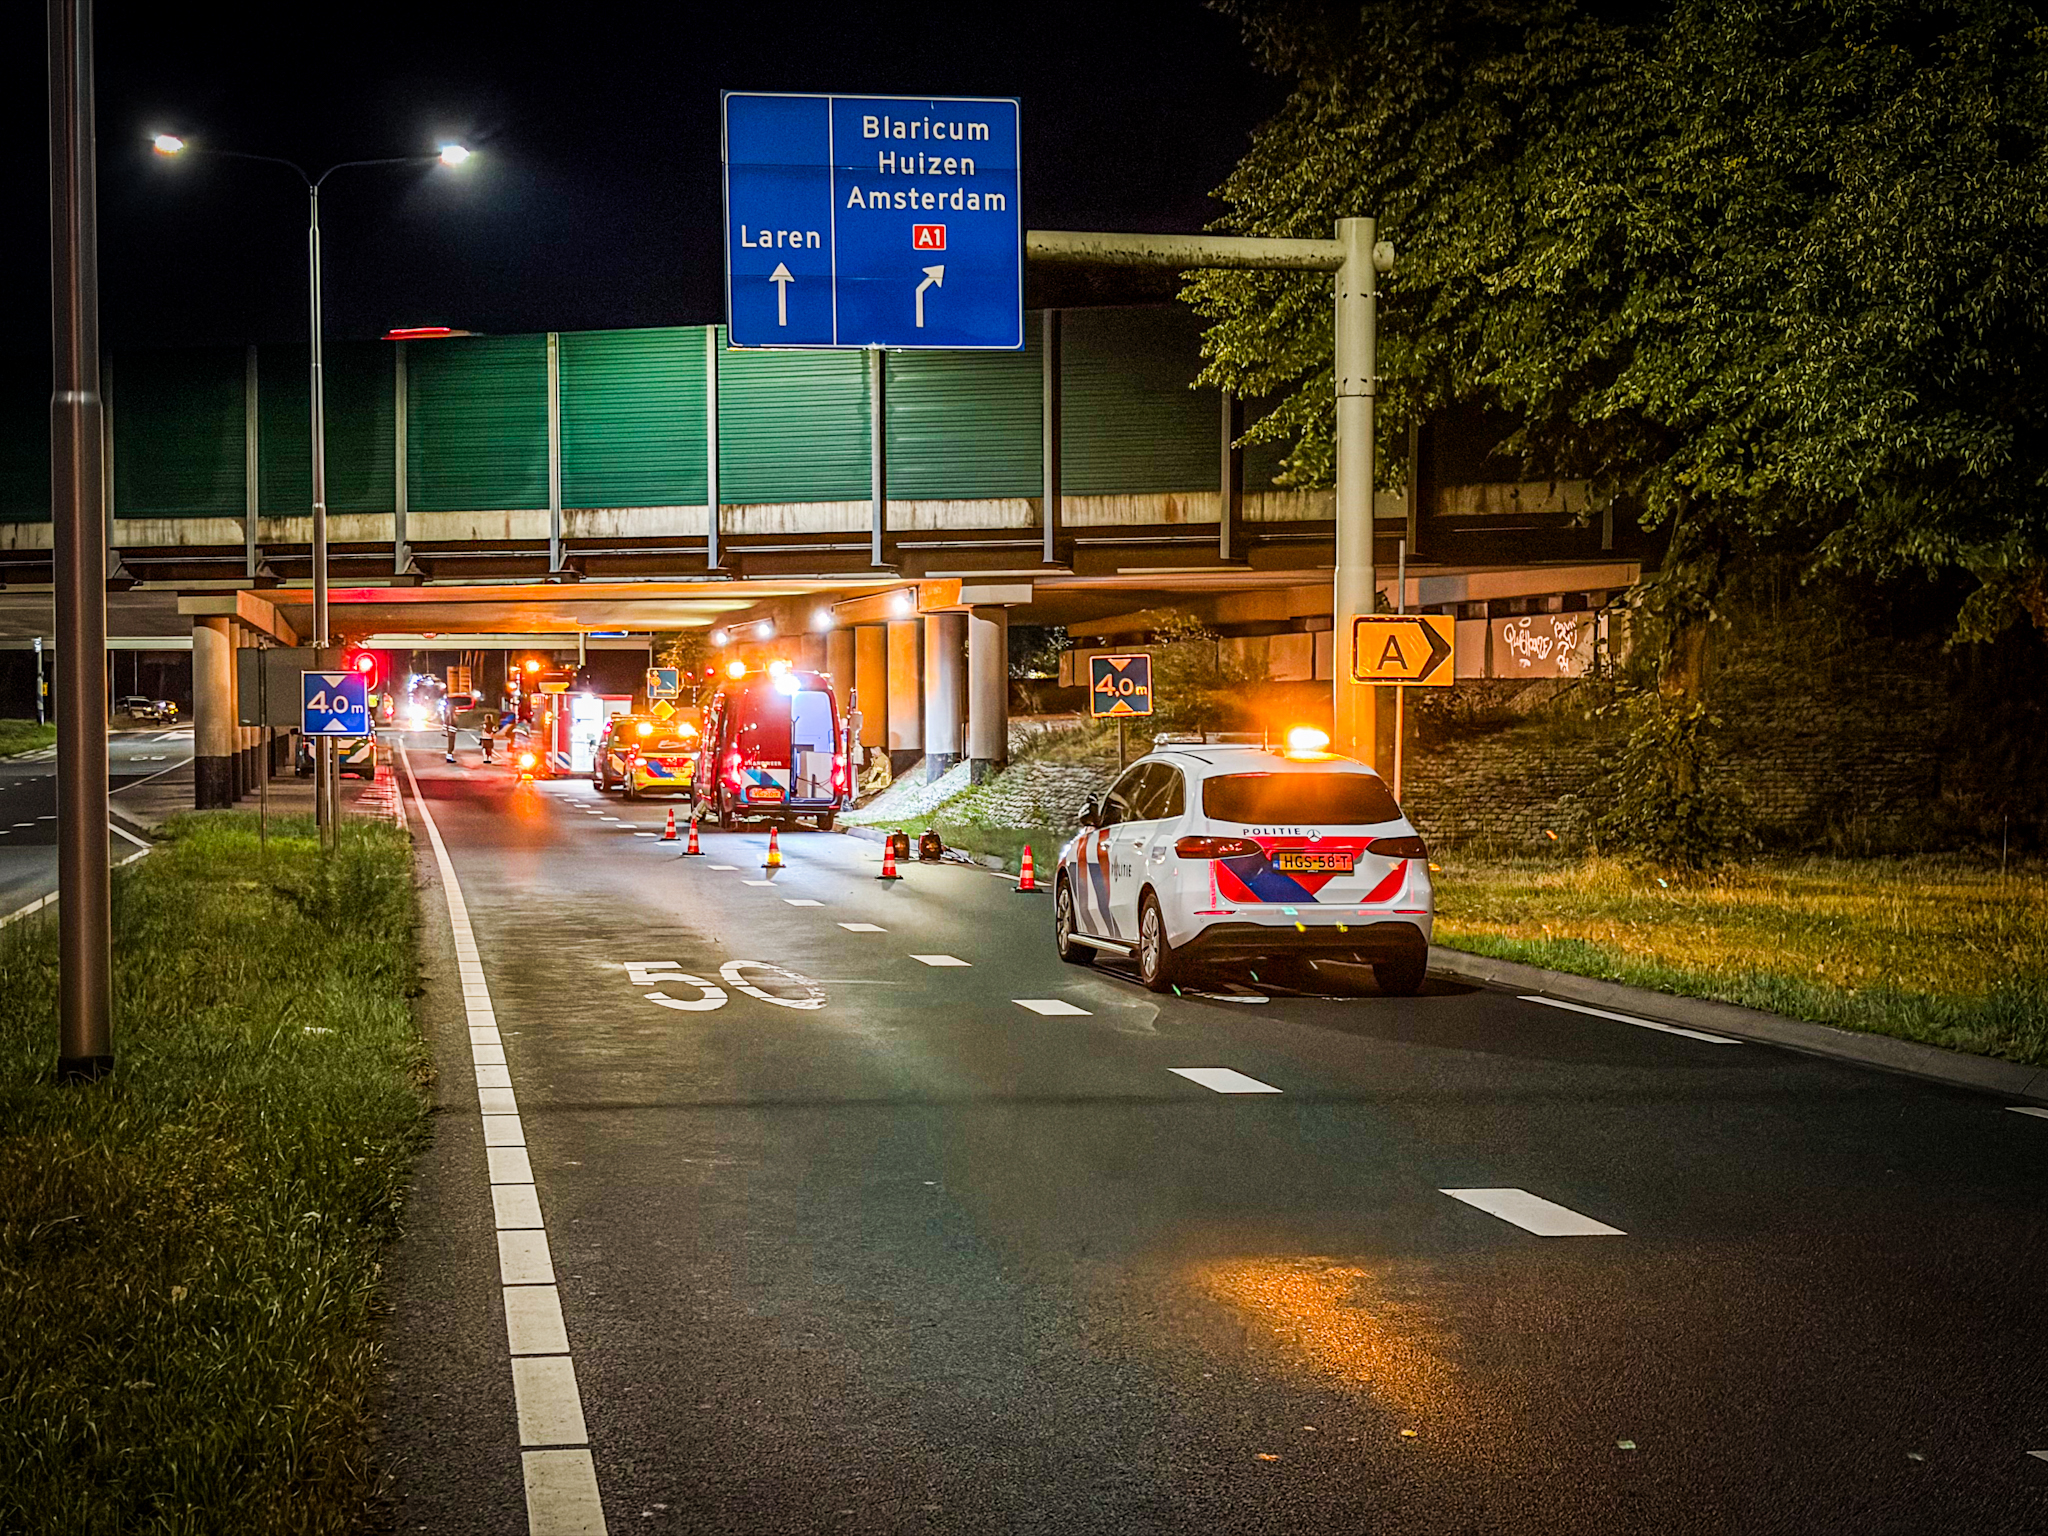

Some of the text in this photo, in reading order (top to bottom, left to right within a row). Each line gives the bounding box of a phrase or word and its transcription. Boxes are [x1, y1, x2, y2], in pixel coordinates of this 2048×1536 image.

[863, 115, 989, 141] Blaricum
[879, 150, 975, 176] Huizen
[846, 185, 1006, 211] Amsterdam
[741, 224, 821, 249] Laren
[918, 228, 941, 246] A1
[1376, 634, 1409, 670] A
[1243, 828, 1301, 836] POLITIE
[1284, 855, 1348, 868] HGS-58-T
[623, 959, 829, 1012] 50
